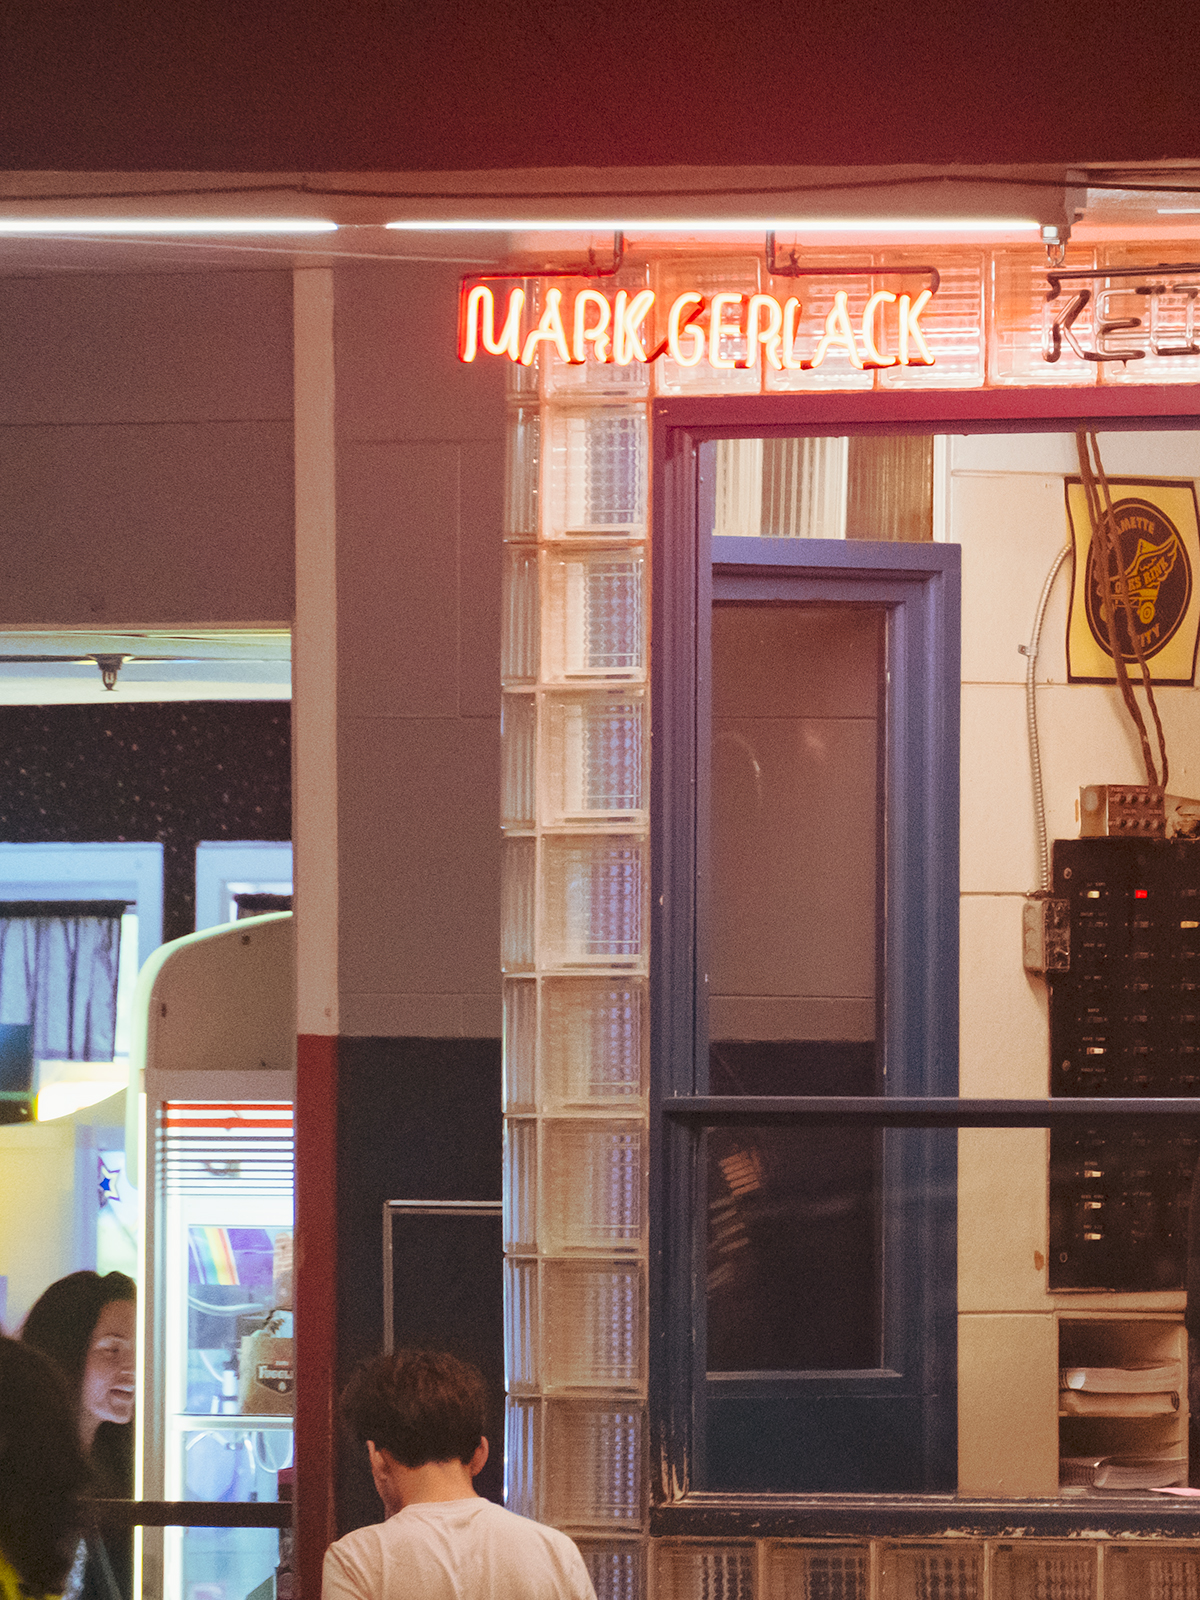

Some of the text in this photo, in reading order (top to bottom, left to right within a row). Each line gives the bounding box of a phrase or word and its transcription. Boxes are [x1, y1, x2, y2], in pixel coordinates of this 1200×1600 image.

[463, 285, 936, 370] MARK GERLACK
[1118, 516, 1156, 535] METTE
[1115, 556, 1169, 594] OKS RINK
